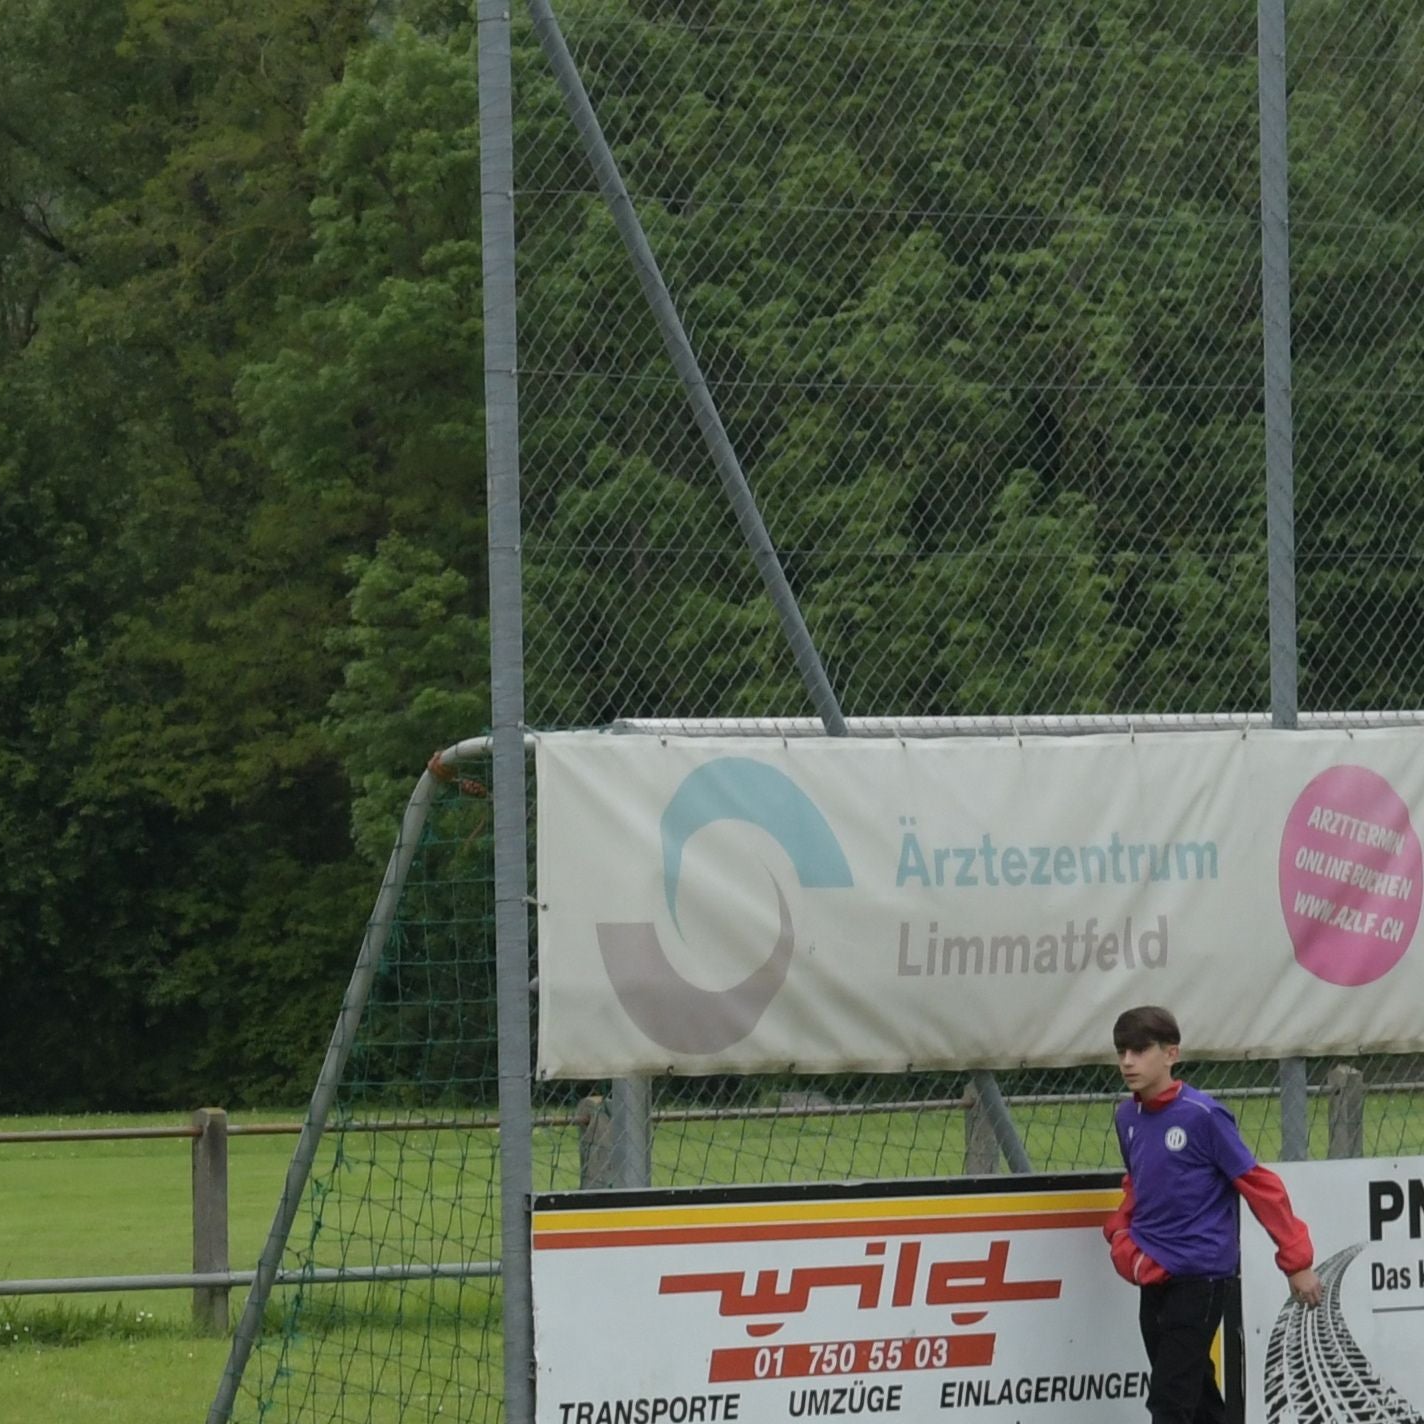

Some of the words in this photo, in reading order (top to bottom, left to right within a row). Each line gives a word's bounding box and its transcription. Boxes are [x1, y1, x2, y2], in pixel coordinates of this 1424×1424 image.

[895, 815, 1219, 887] Ärztezentrum
[1307, 806, 1405, 856] ARZTTERMIN
[1294, 846, 1352, 884] ONLINE
[1351, 864, 1413, 901] BUCHEN
[1293, 890, 1404, 943] WWW.AZLF.CH
[897, 914, 1170, 977] Limmatfeld
[659, 1240, 1063, 1317] wild
[1371, 1261, 1412, 1292] Das
[754, 1346, 785, 1379] 01
[807, 1342, 856, 1375] 750
[867, 1340, 903, 1371] 55
[914, 1337, 949, 1369] 03
[788, 1380, 903, 1417] UMZÜGE
